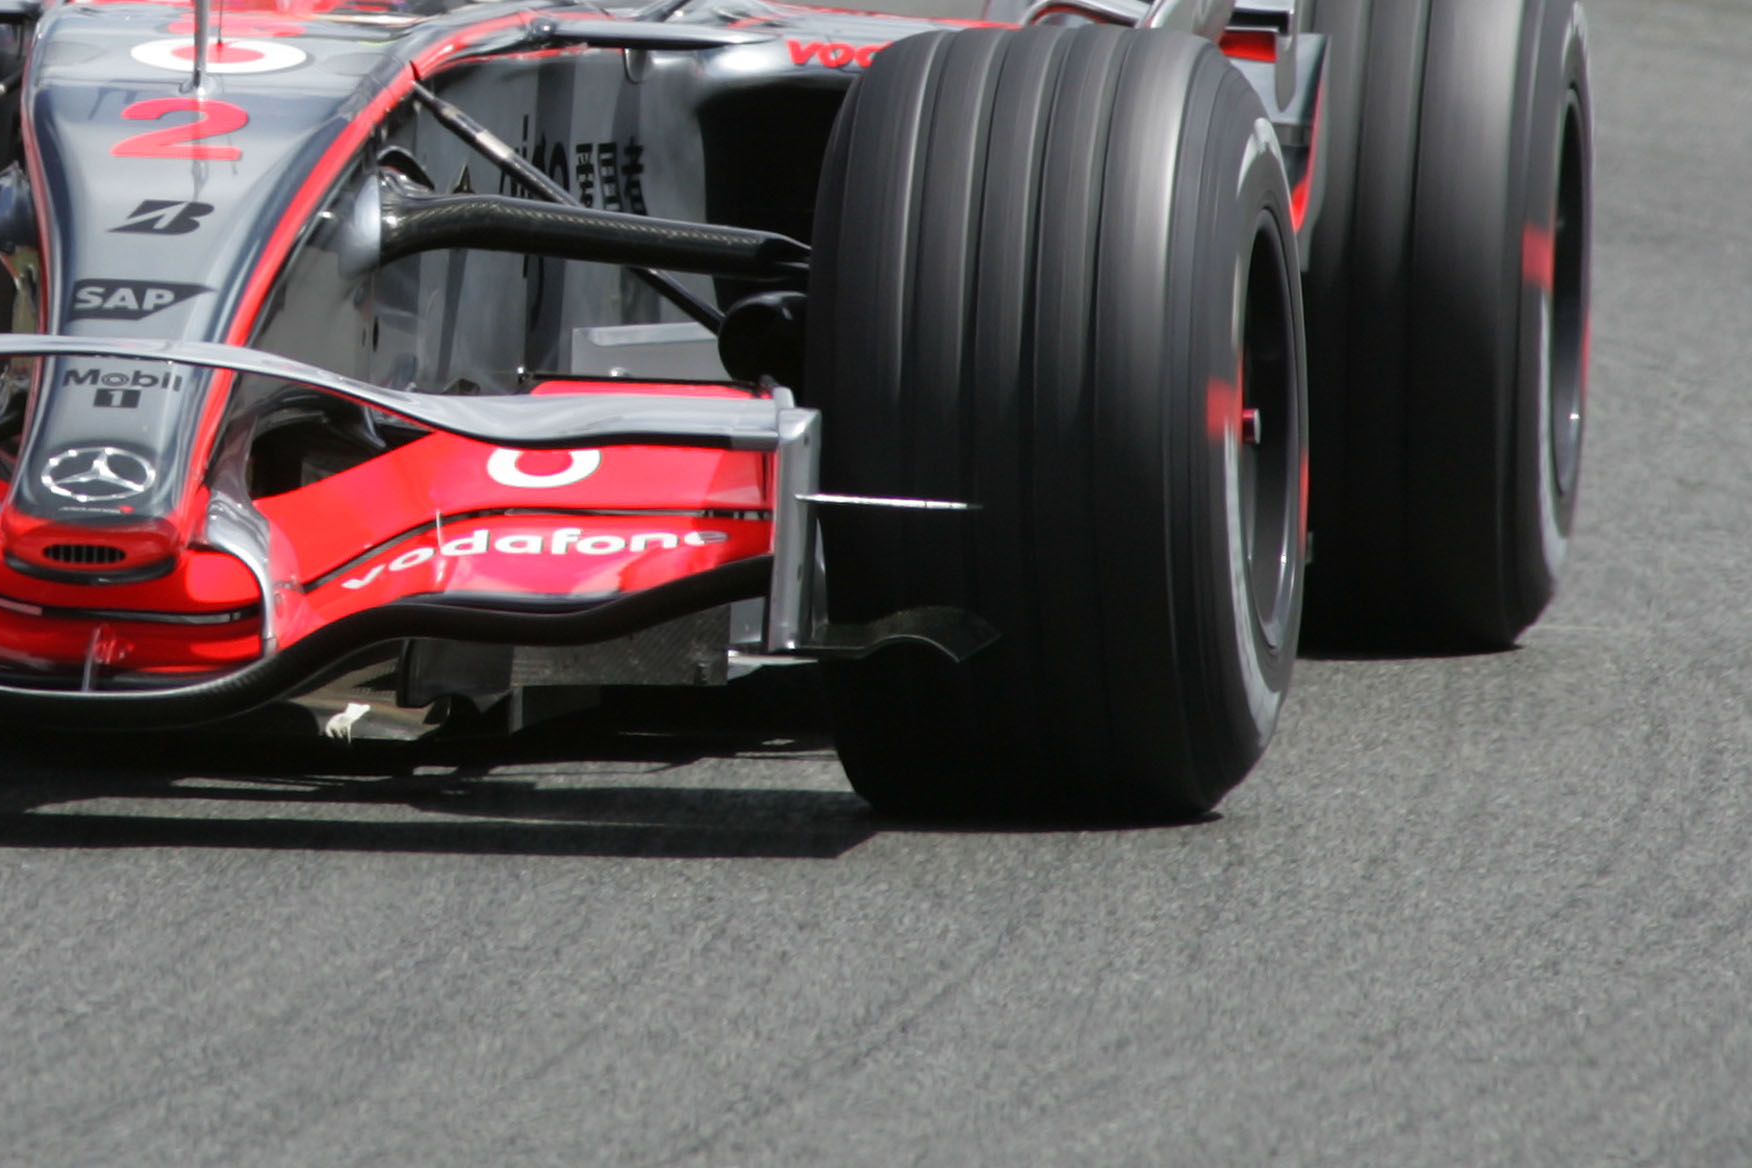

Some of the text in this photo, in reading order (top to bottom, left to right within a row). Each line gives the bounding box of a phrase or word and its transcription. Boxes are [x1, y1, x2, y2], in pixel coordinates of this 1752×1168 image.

[109, 97, 249, 162] 2
[74, 287, 175, 311] SAP
[62, 368, 183, 392] Mobil
[341, 528, 729, 589] vodafone
